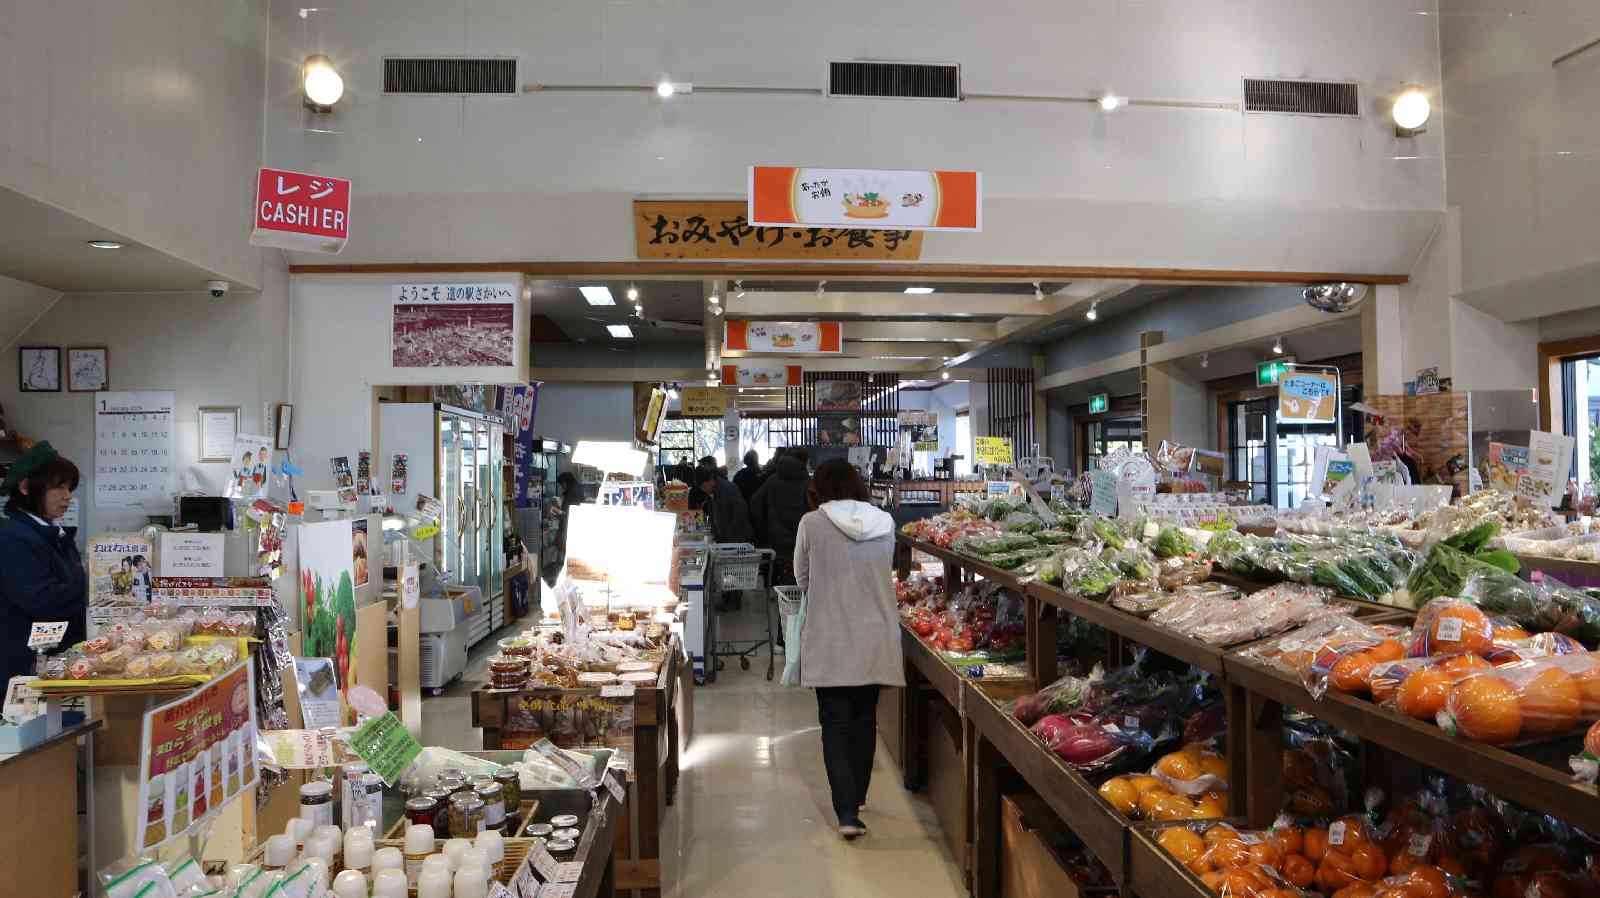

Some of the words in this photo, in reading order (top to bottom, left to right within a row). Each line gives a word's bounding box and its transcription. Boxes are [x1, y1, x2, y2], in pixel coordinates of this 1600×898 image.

[277, 175, 334, 199] レジ
[261, 200, 344, 231] CASHIER
[399, 286, 440, 301] ようこそ
[447, 286, 512, 300] 道の駅さかいへ
[100, 399, 106, 411] 1
